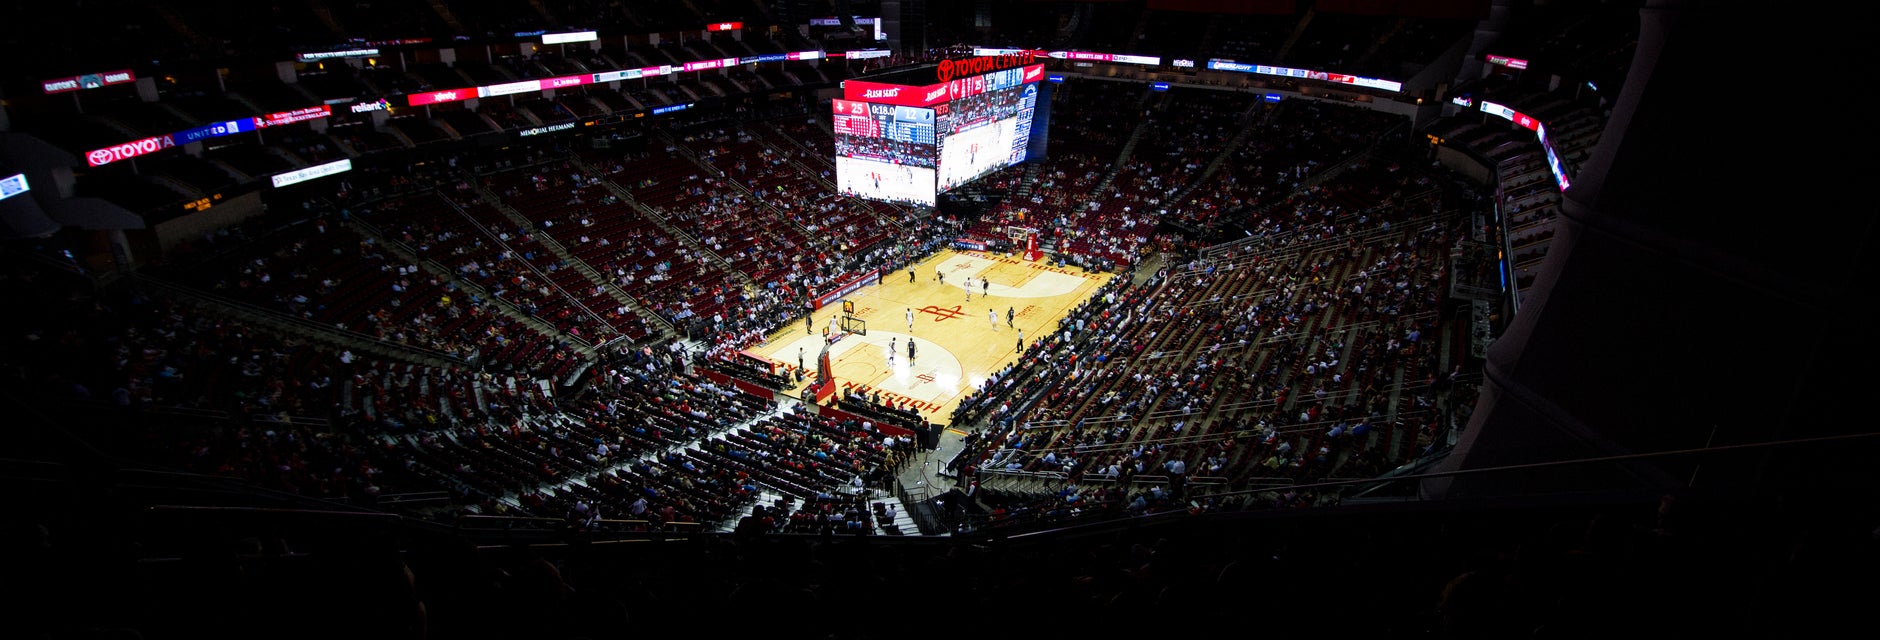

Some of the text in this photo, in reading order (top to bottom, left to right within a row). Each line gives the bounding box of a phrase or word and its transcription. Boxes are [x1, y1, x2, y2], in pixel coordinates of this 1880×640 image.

[955, 50, 1035, 76] TOYOTA CENTER
[351, 101, 381, 113] reliant
[851, 103, 863, 114] 25
[872, 105, 894, 116] 0:18.0
[905, 109, 917, 120] 12
[187, 126, 225, 140] UNITED
[520, 126, 548, 136] MEMORIAL
[548, 122, 575, 132] HERMANN
[111, 135, 175, 160] TOYOTA
